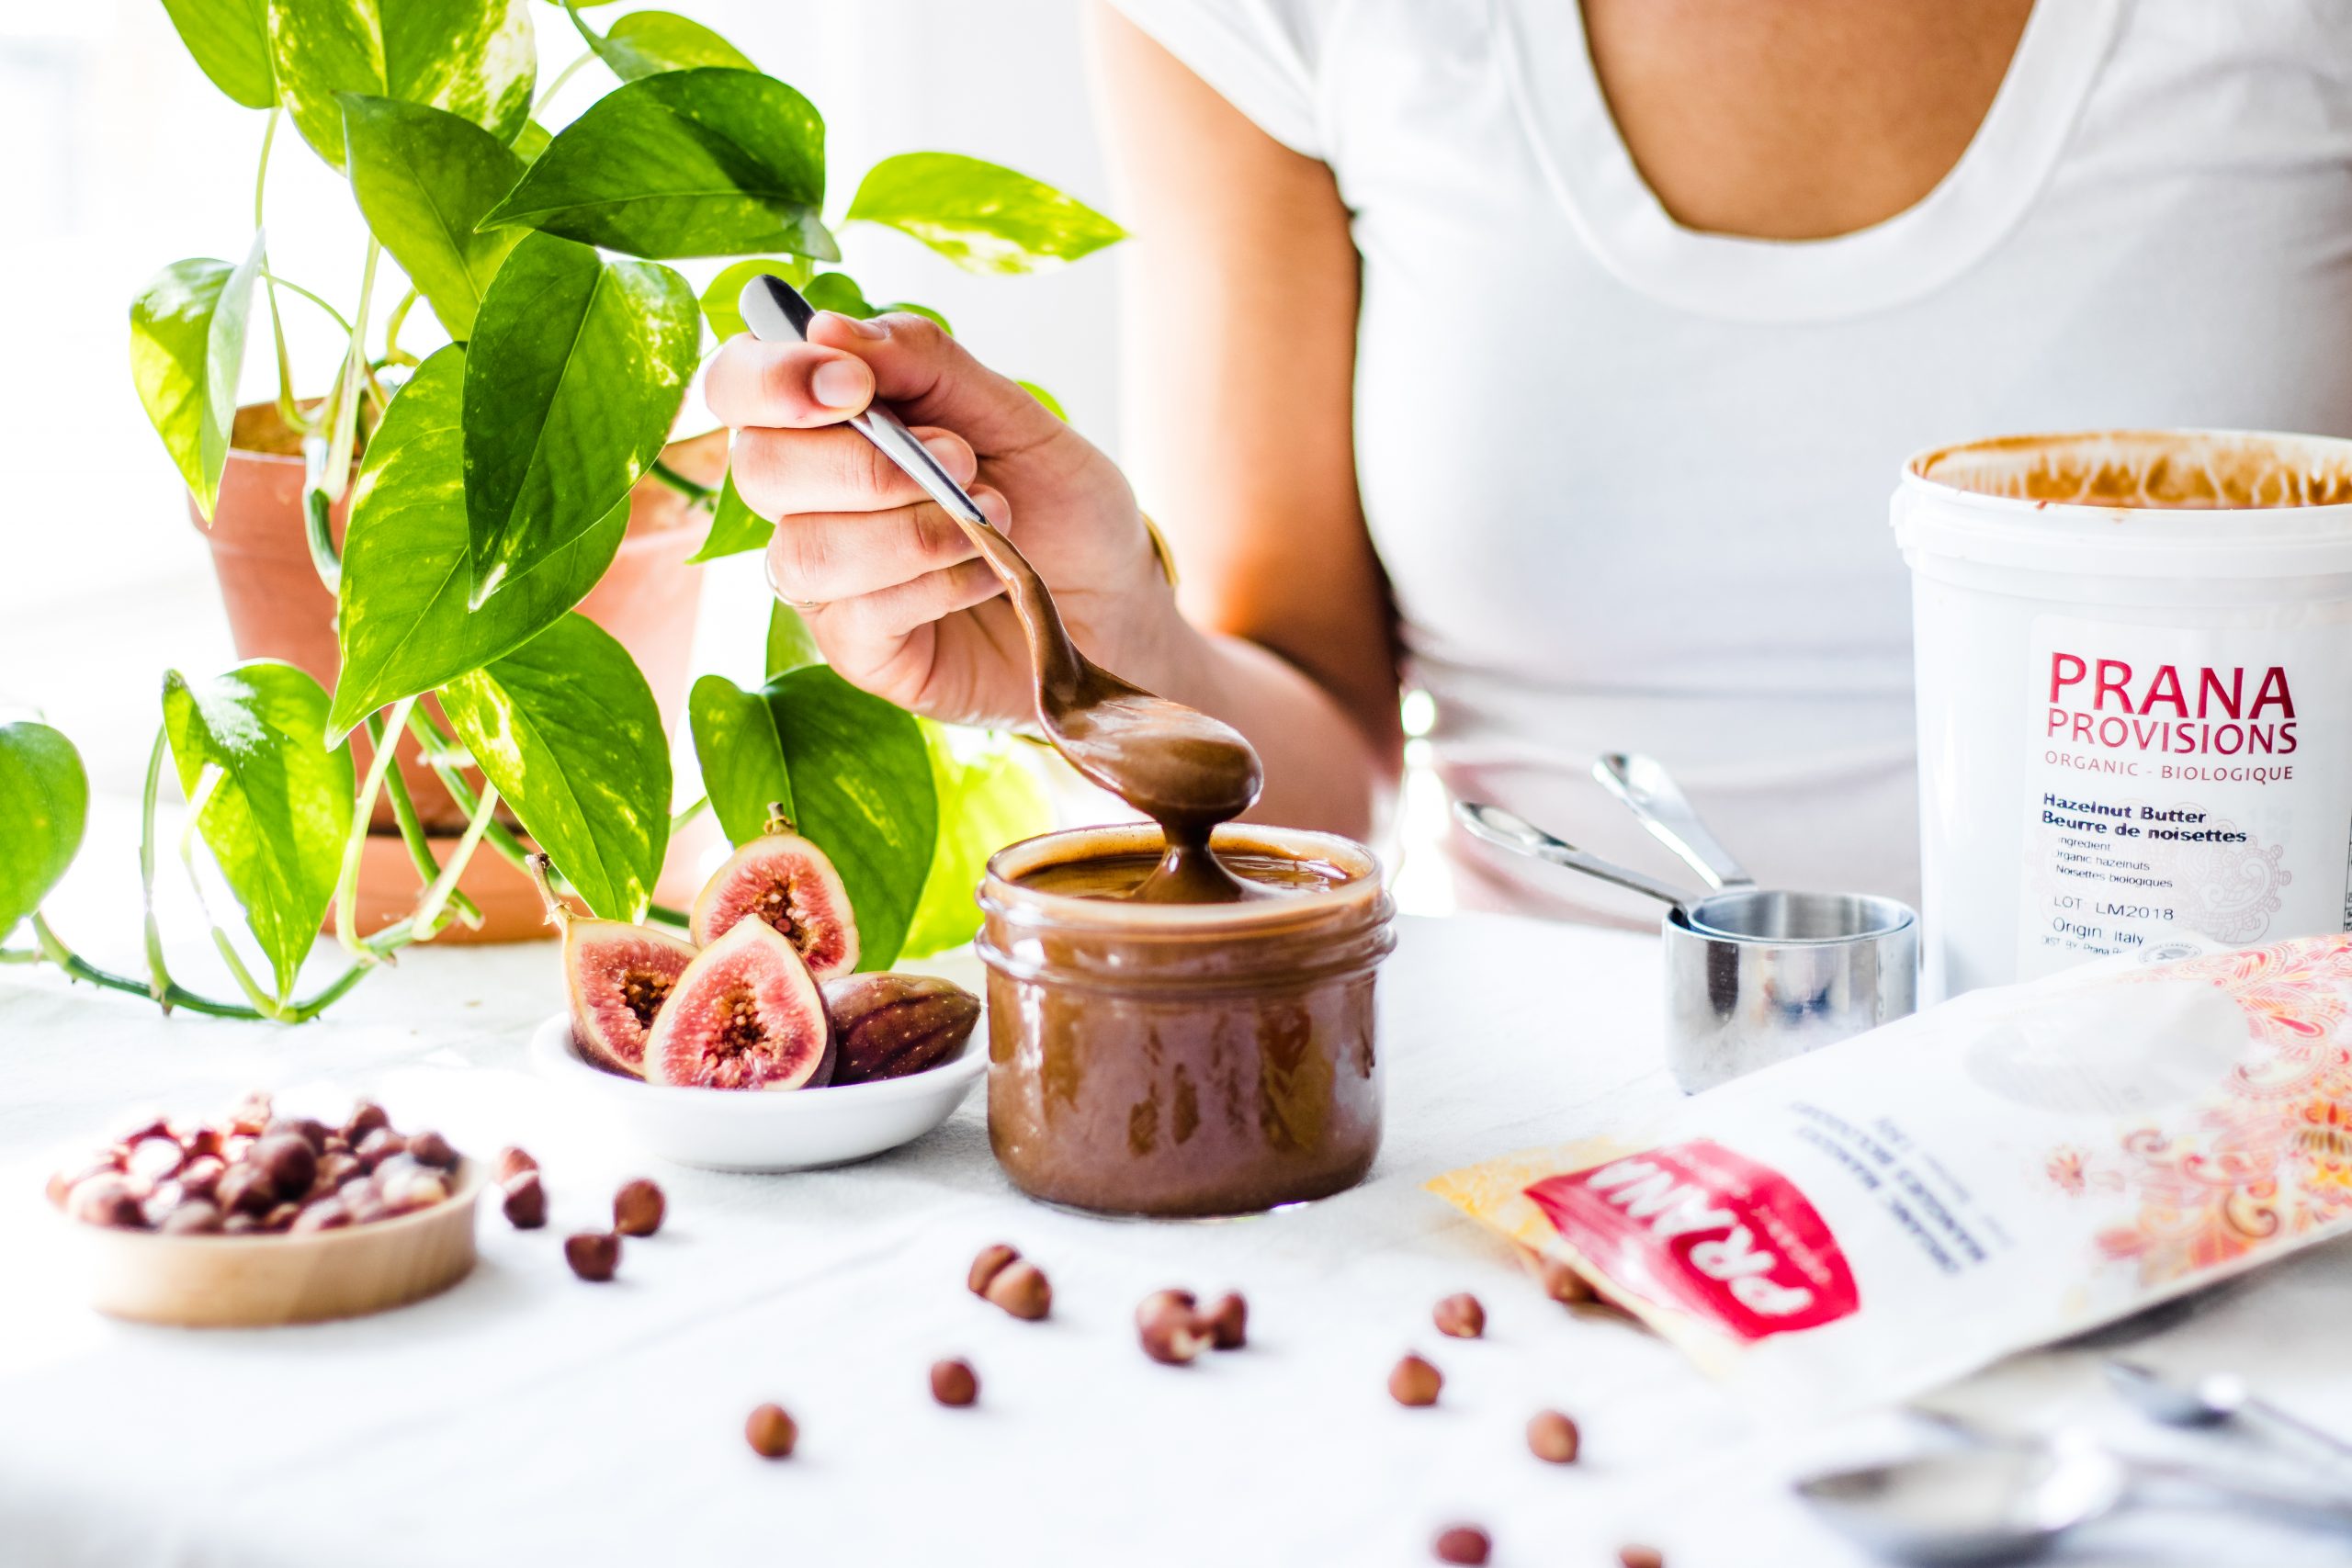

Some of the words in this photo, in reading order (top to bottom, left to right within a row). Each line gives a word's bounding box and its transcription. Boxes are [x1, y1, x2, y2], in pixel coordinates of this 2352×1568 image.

[2049, 651, 2296, 719] PRANA
[2047, 708, 2297, 755] PROVISIONS
[2045, 750, 2139, 776] ORGANIC
[2161, 765, 2293, 785] BIOLOGIQUE
[2043, 792, 2132, 818] Hazelnut
[2140, 807, 2207, 824] Butter
[2041, 810, 2108, 834] Beurre
[2114, 822, 2141, 838] de
[2147, 826, 2247, 843] noisettes
[2056, 864, 2106, 881] Noisettes
[2109, 874, 2173, 888] biologiques
[2096, 858, 2151, 872] hazelnuts
[2053, 896, 2084, 910] LOT
[2096, 902, 2174, 920] LM2018
[2114, 931, 2144, 947] Italy
[1587, 1160, 1813, 1315] PRANA
